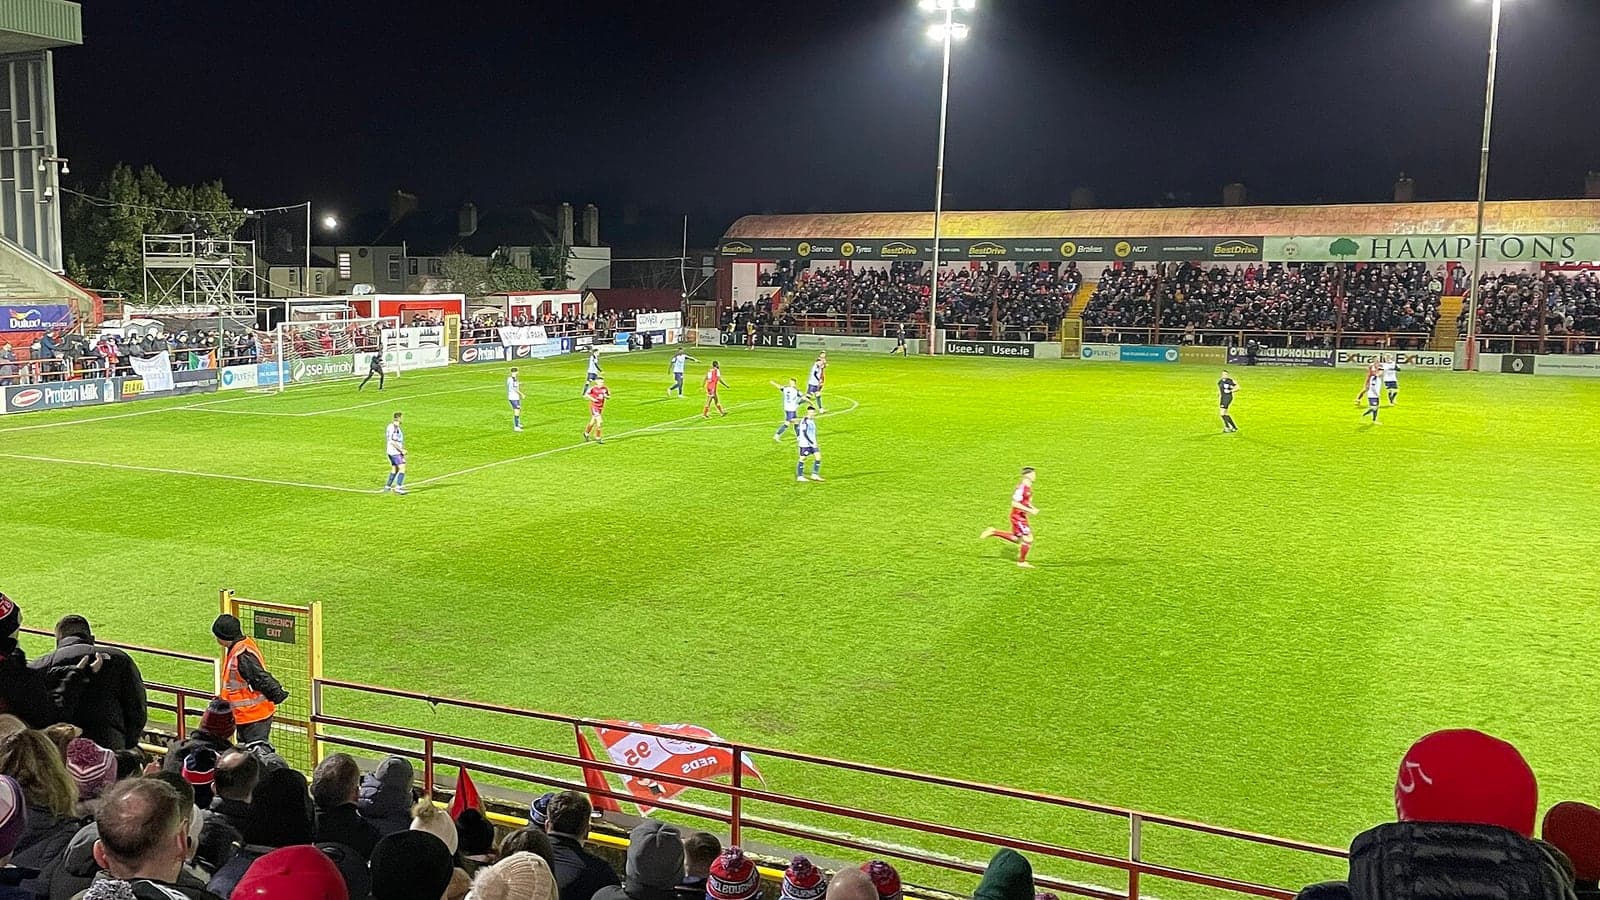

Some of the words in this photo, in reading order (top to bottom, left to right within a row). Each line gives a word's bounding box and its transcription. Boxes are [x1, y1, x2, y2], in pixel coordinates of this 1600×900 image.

[811, 245, 834, 253] Service
[855, 246, 872, 254] Tyres
[881, 247, 918, 255] BestDrive
[968, 247, 1007, 255] BestDrive
[1077, 245, 1104, 253] Brakes
[1214, 246, 1258, 254] BestDrive
[1371, 236, 1576, 259] HAMPTONS
[721, 333, 796, 346] DIFFNEY
[948, 343, 985, 354] Usee.ie
[992, 345, 1030, 356] Usee.ie
[1276, 348, 1333, 359] UPHOLSTERY
[1396, 353, 1452, 366] Extra.ie
[44, 385, 79, 405] Protein
[79, 383, 99, 401] Milk
[255, 615, 294, 628] EMERGENCY
[266, 628, 282, 638] EXIT
